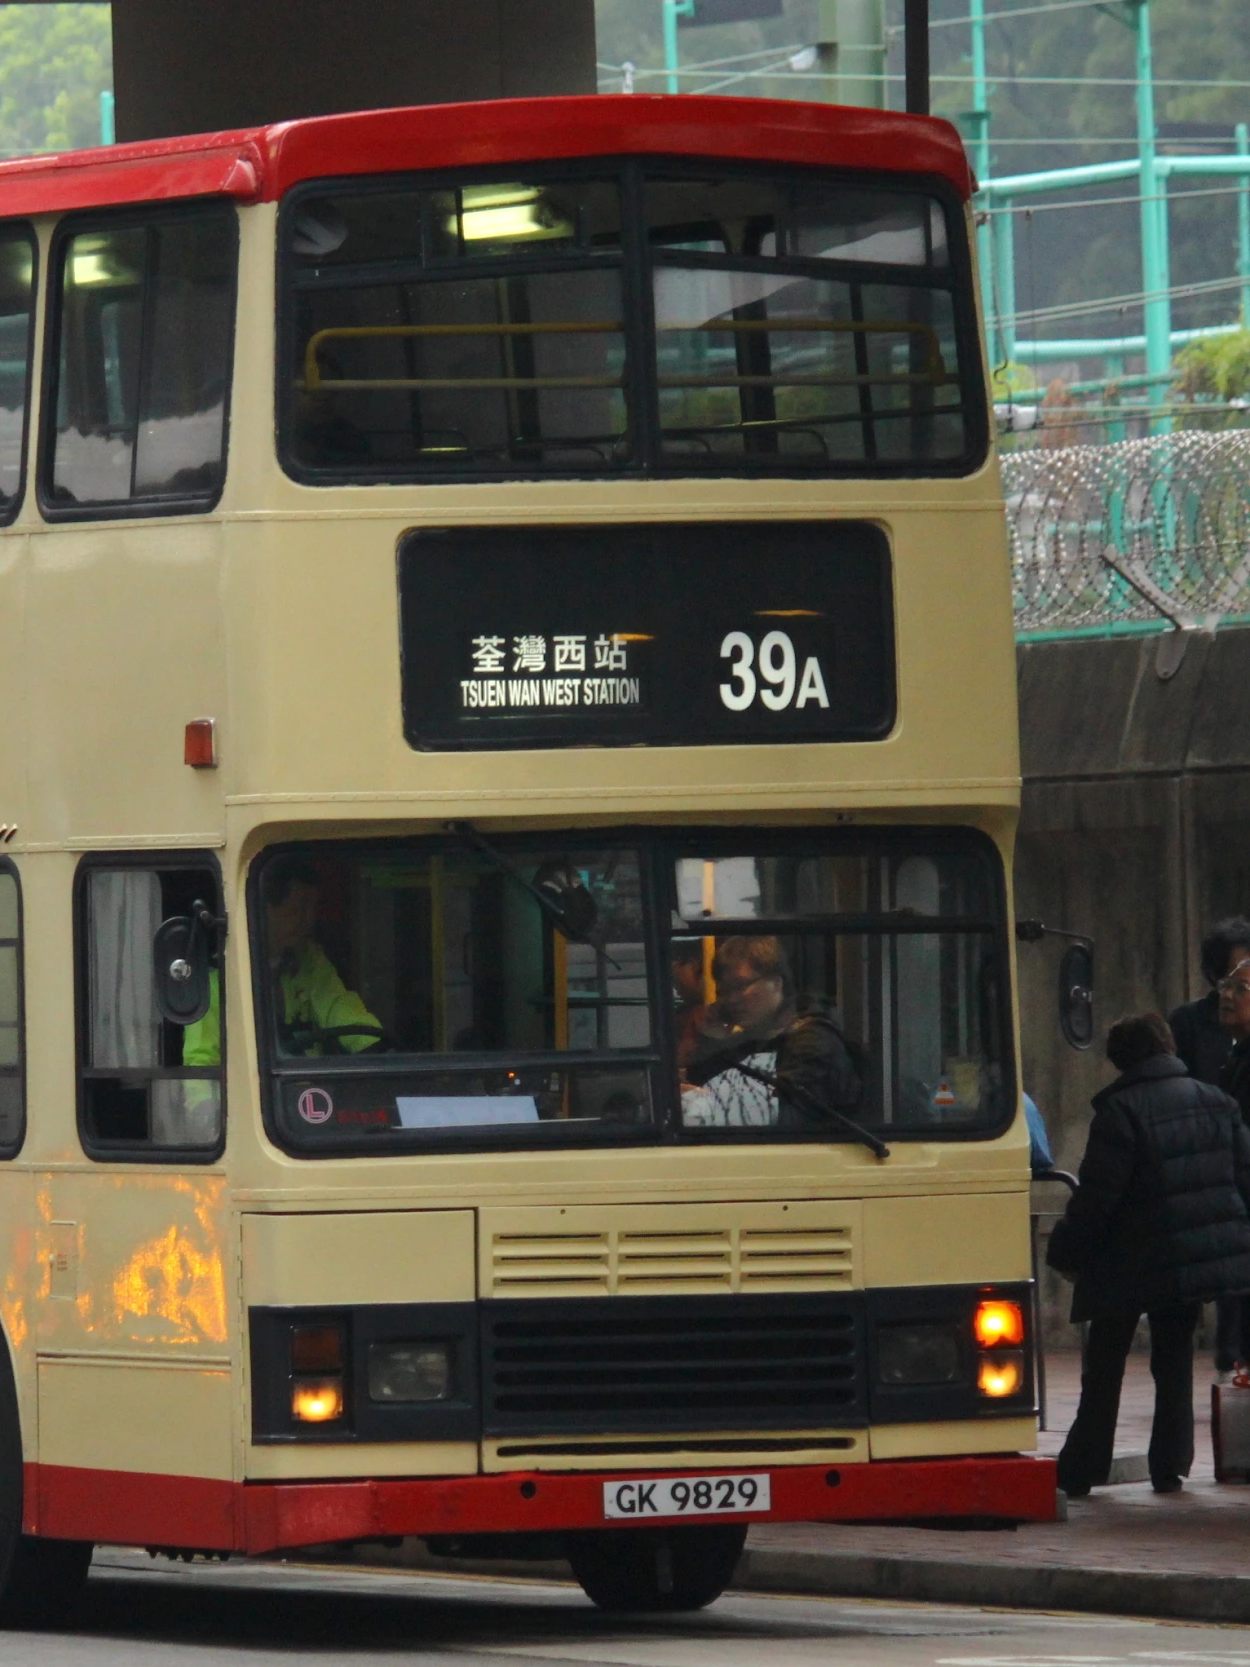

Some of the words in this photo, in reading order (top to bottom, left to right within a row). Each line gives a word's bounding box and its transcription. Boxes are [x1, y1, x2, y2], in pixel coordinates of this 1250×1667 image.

[471, 633, 627, 673] 荃灣西站
[719, 630, 830, 711] 39A
[460, 679, 506, 707] TSUEN
[508, 679, 540, 706] WAN
[542, 678, 581, 706] WEST
[583, 677, 640, 705] STATION
[616, 1483, 658, 1513] GK
[670, 1478, 758, 1512] 9829
